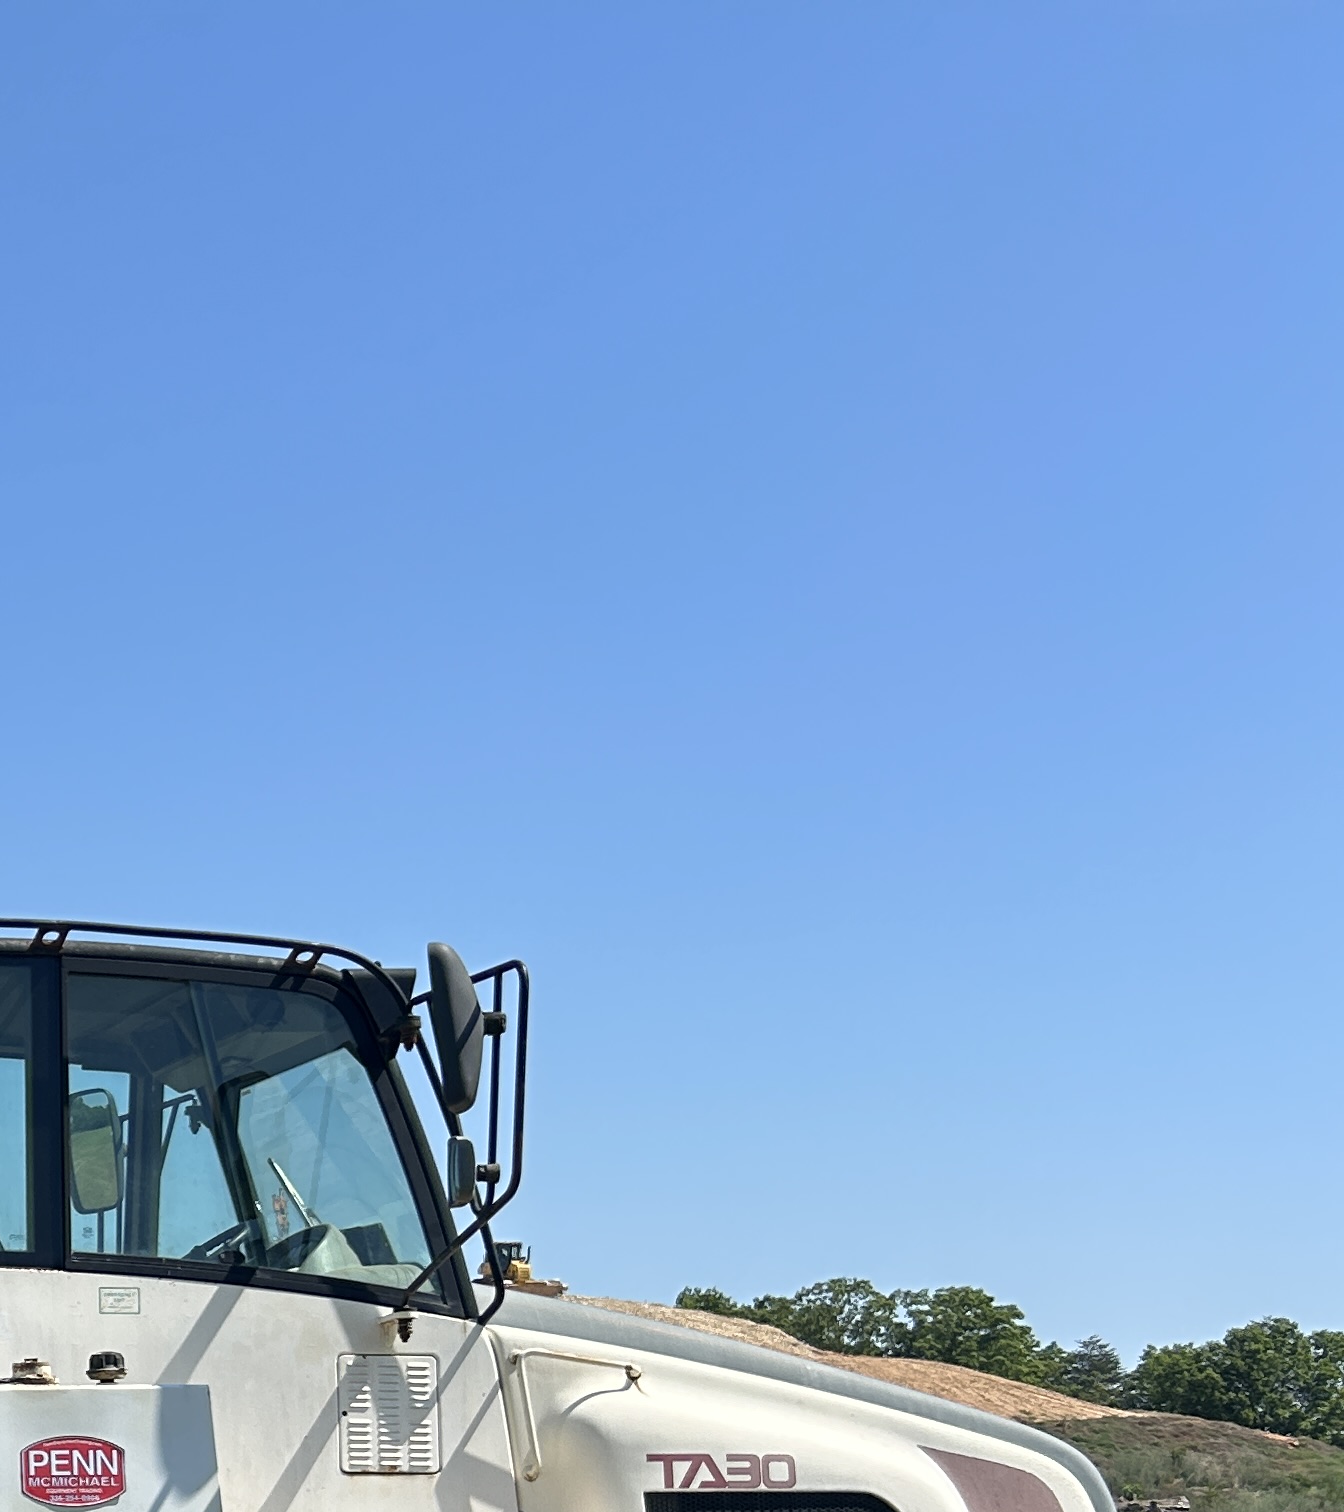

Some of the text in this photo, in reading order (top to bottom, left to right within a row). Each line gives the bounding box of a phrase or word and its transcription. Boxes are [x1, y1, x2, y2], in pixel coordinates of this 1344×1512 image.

[28, 1449, 119, 1476] PENN
[645, 1453, 797, 1489] TA30
[28, 1476, 120, 1487] MCMICHAEL
